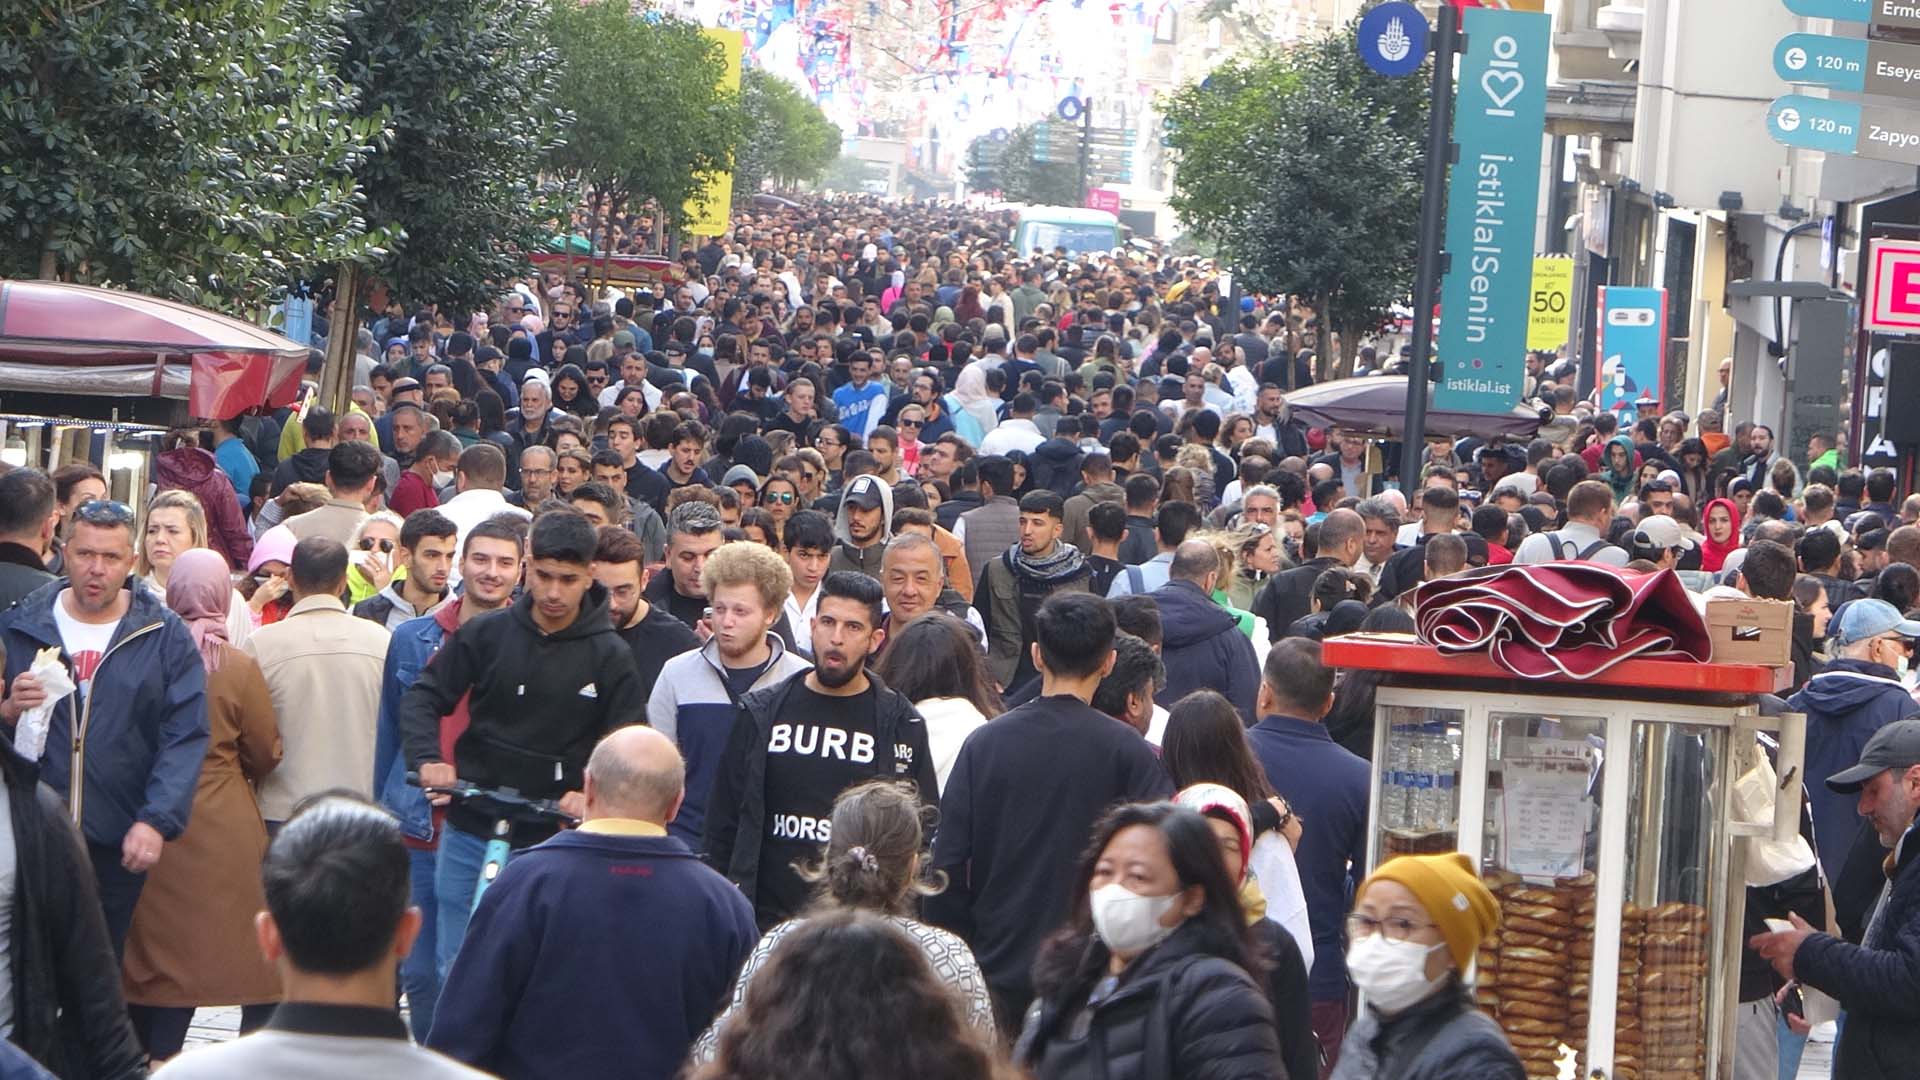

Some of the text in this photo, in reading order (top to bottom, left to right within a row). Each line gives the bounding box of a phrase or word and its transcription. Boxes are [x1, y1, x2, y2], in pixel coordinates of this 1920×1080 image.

[1815, 55, 1920, 82] 120 m Eseya
[1808, 117, 1920, 147] 120 m Zapyo
[1466, 153, 1515, 343] istiklalSenin
[1533, 290, 1566, 313] 50
[1447, 378, 1511, 395] istiklal.ist
[767, 723, 875, 764] BURB
[773, 814, 833, 842] HORS
